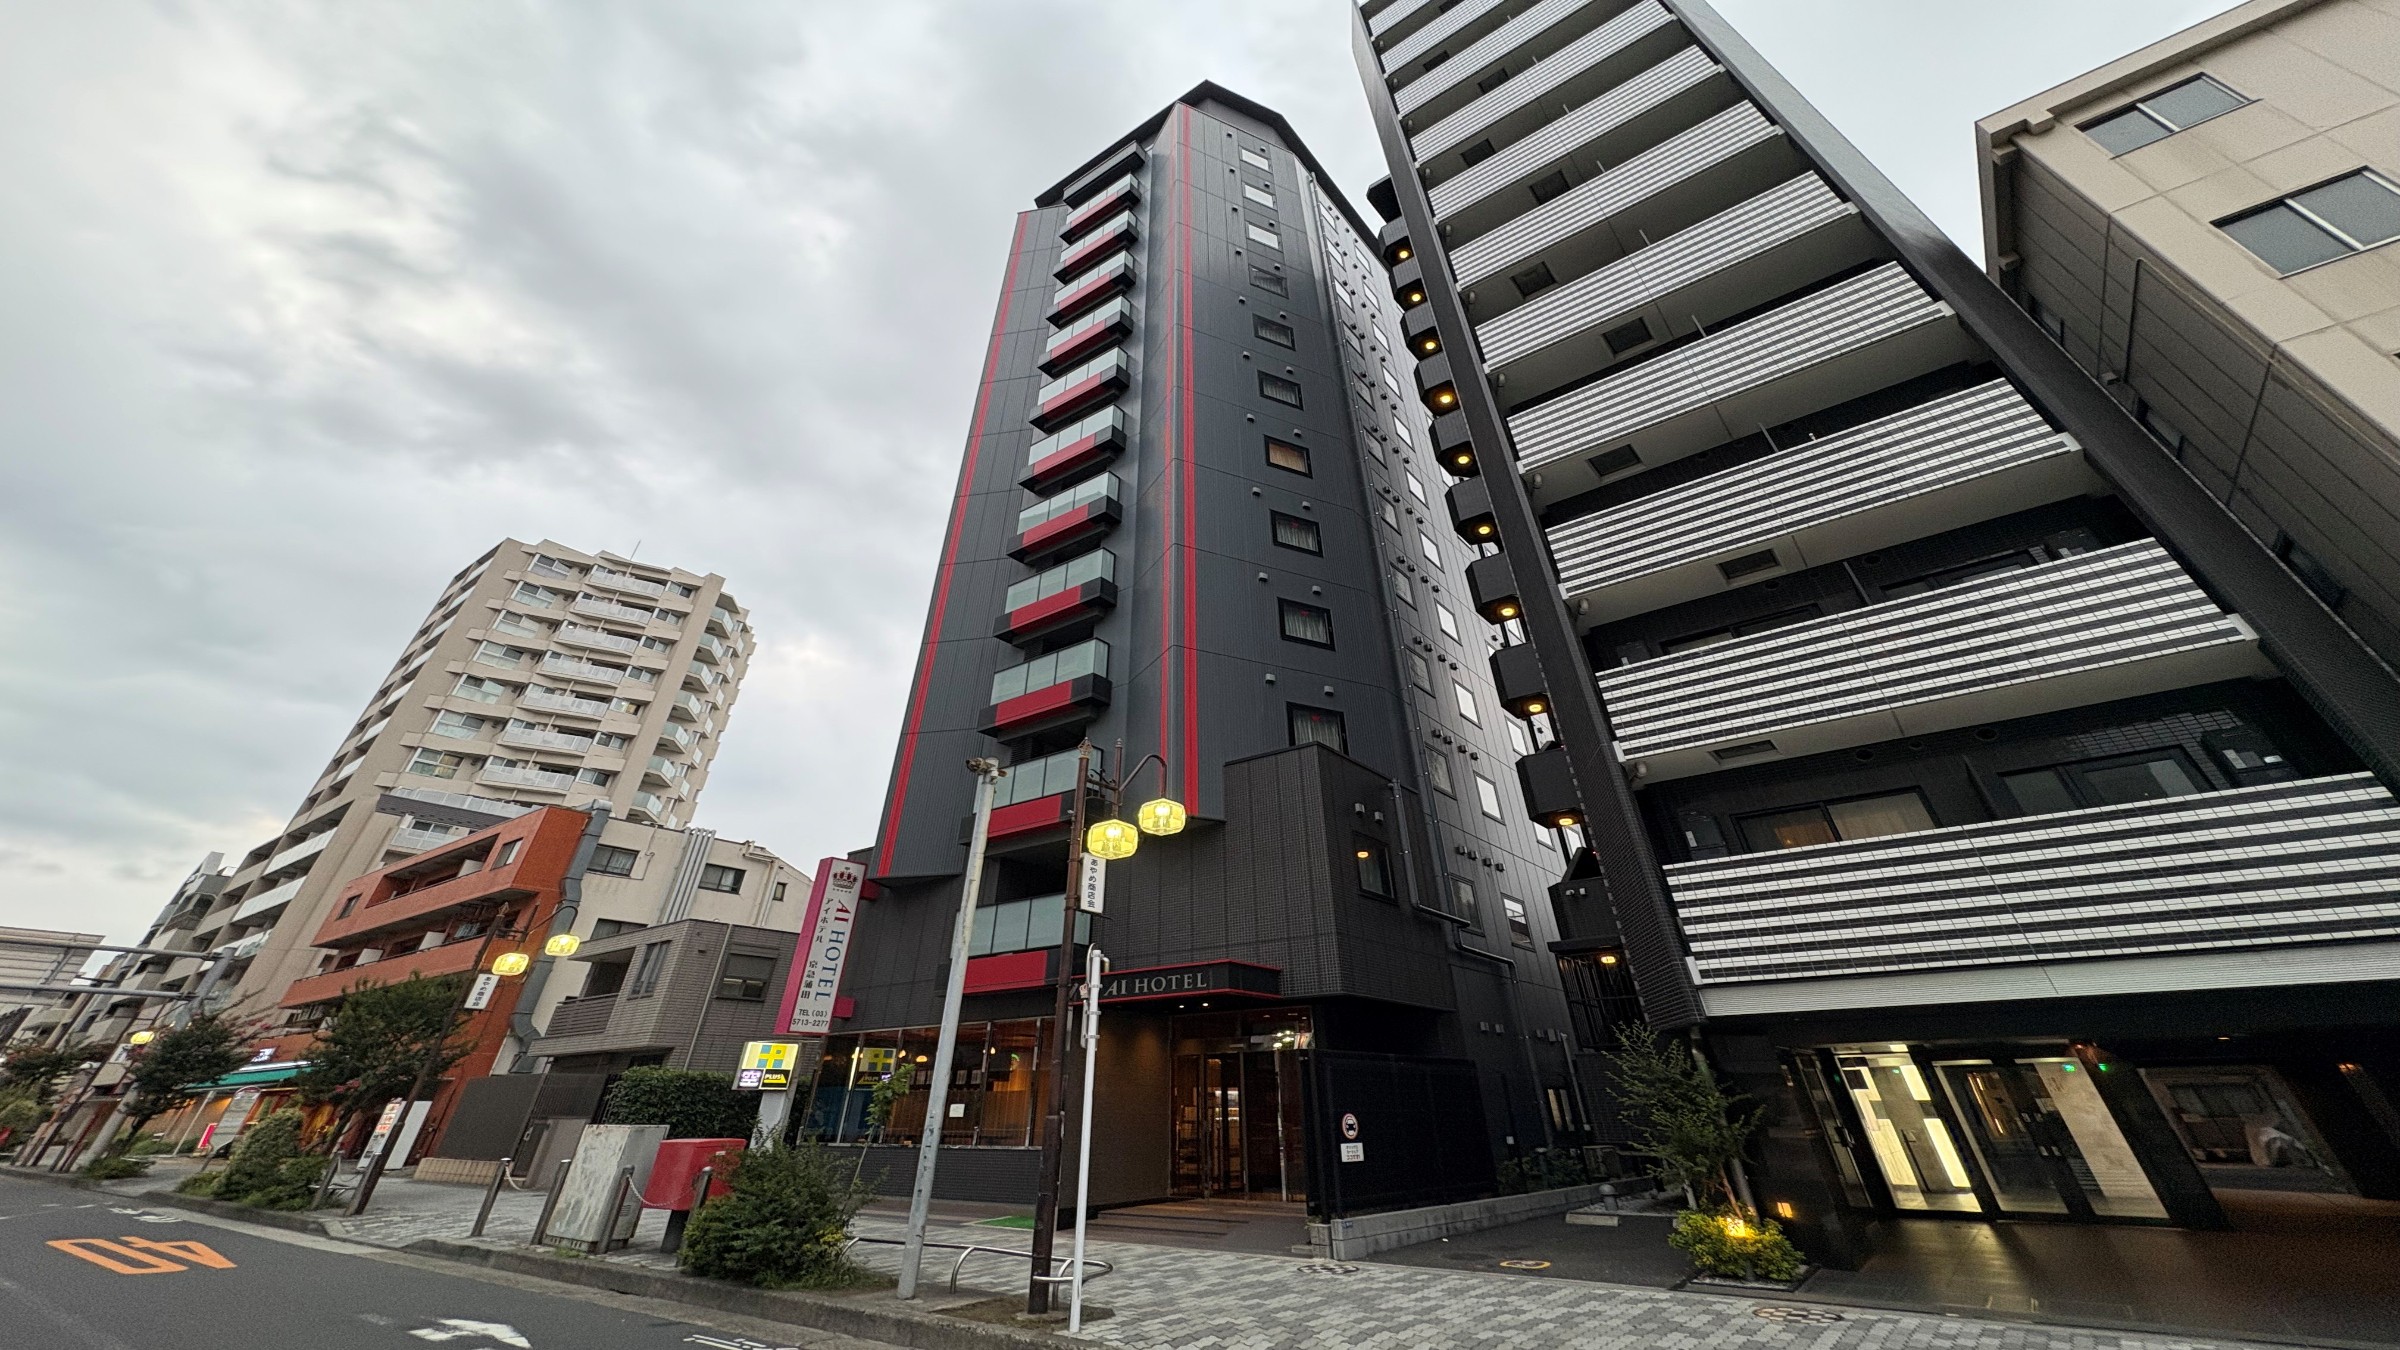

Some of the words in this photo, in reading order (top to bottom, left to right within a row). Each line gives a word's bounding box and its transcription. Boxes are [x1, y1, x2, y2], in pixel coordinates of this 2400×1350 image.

[1087, 858, 1098, 909] あやめ商店会
[815, 898, 834, 943] アイホテル
[834, 899, 851, 923] AI
[814, 929, 846, 1001] HOTEL
[1104, 979, 1128, 996] AI
[1135, 972, 1207, 993] HOTEL
[791, 1018, 829, 1027] 5713-2277
[798, 1008, 810, 1016] TEL
[45, 1235, 238, 1275] 40
